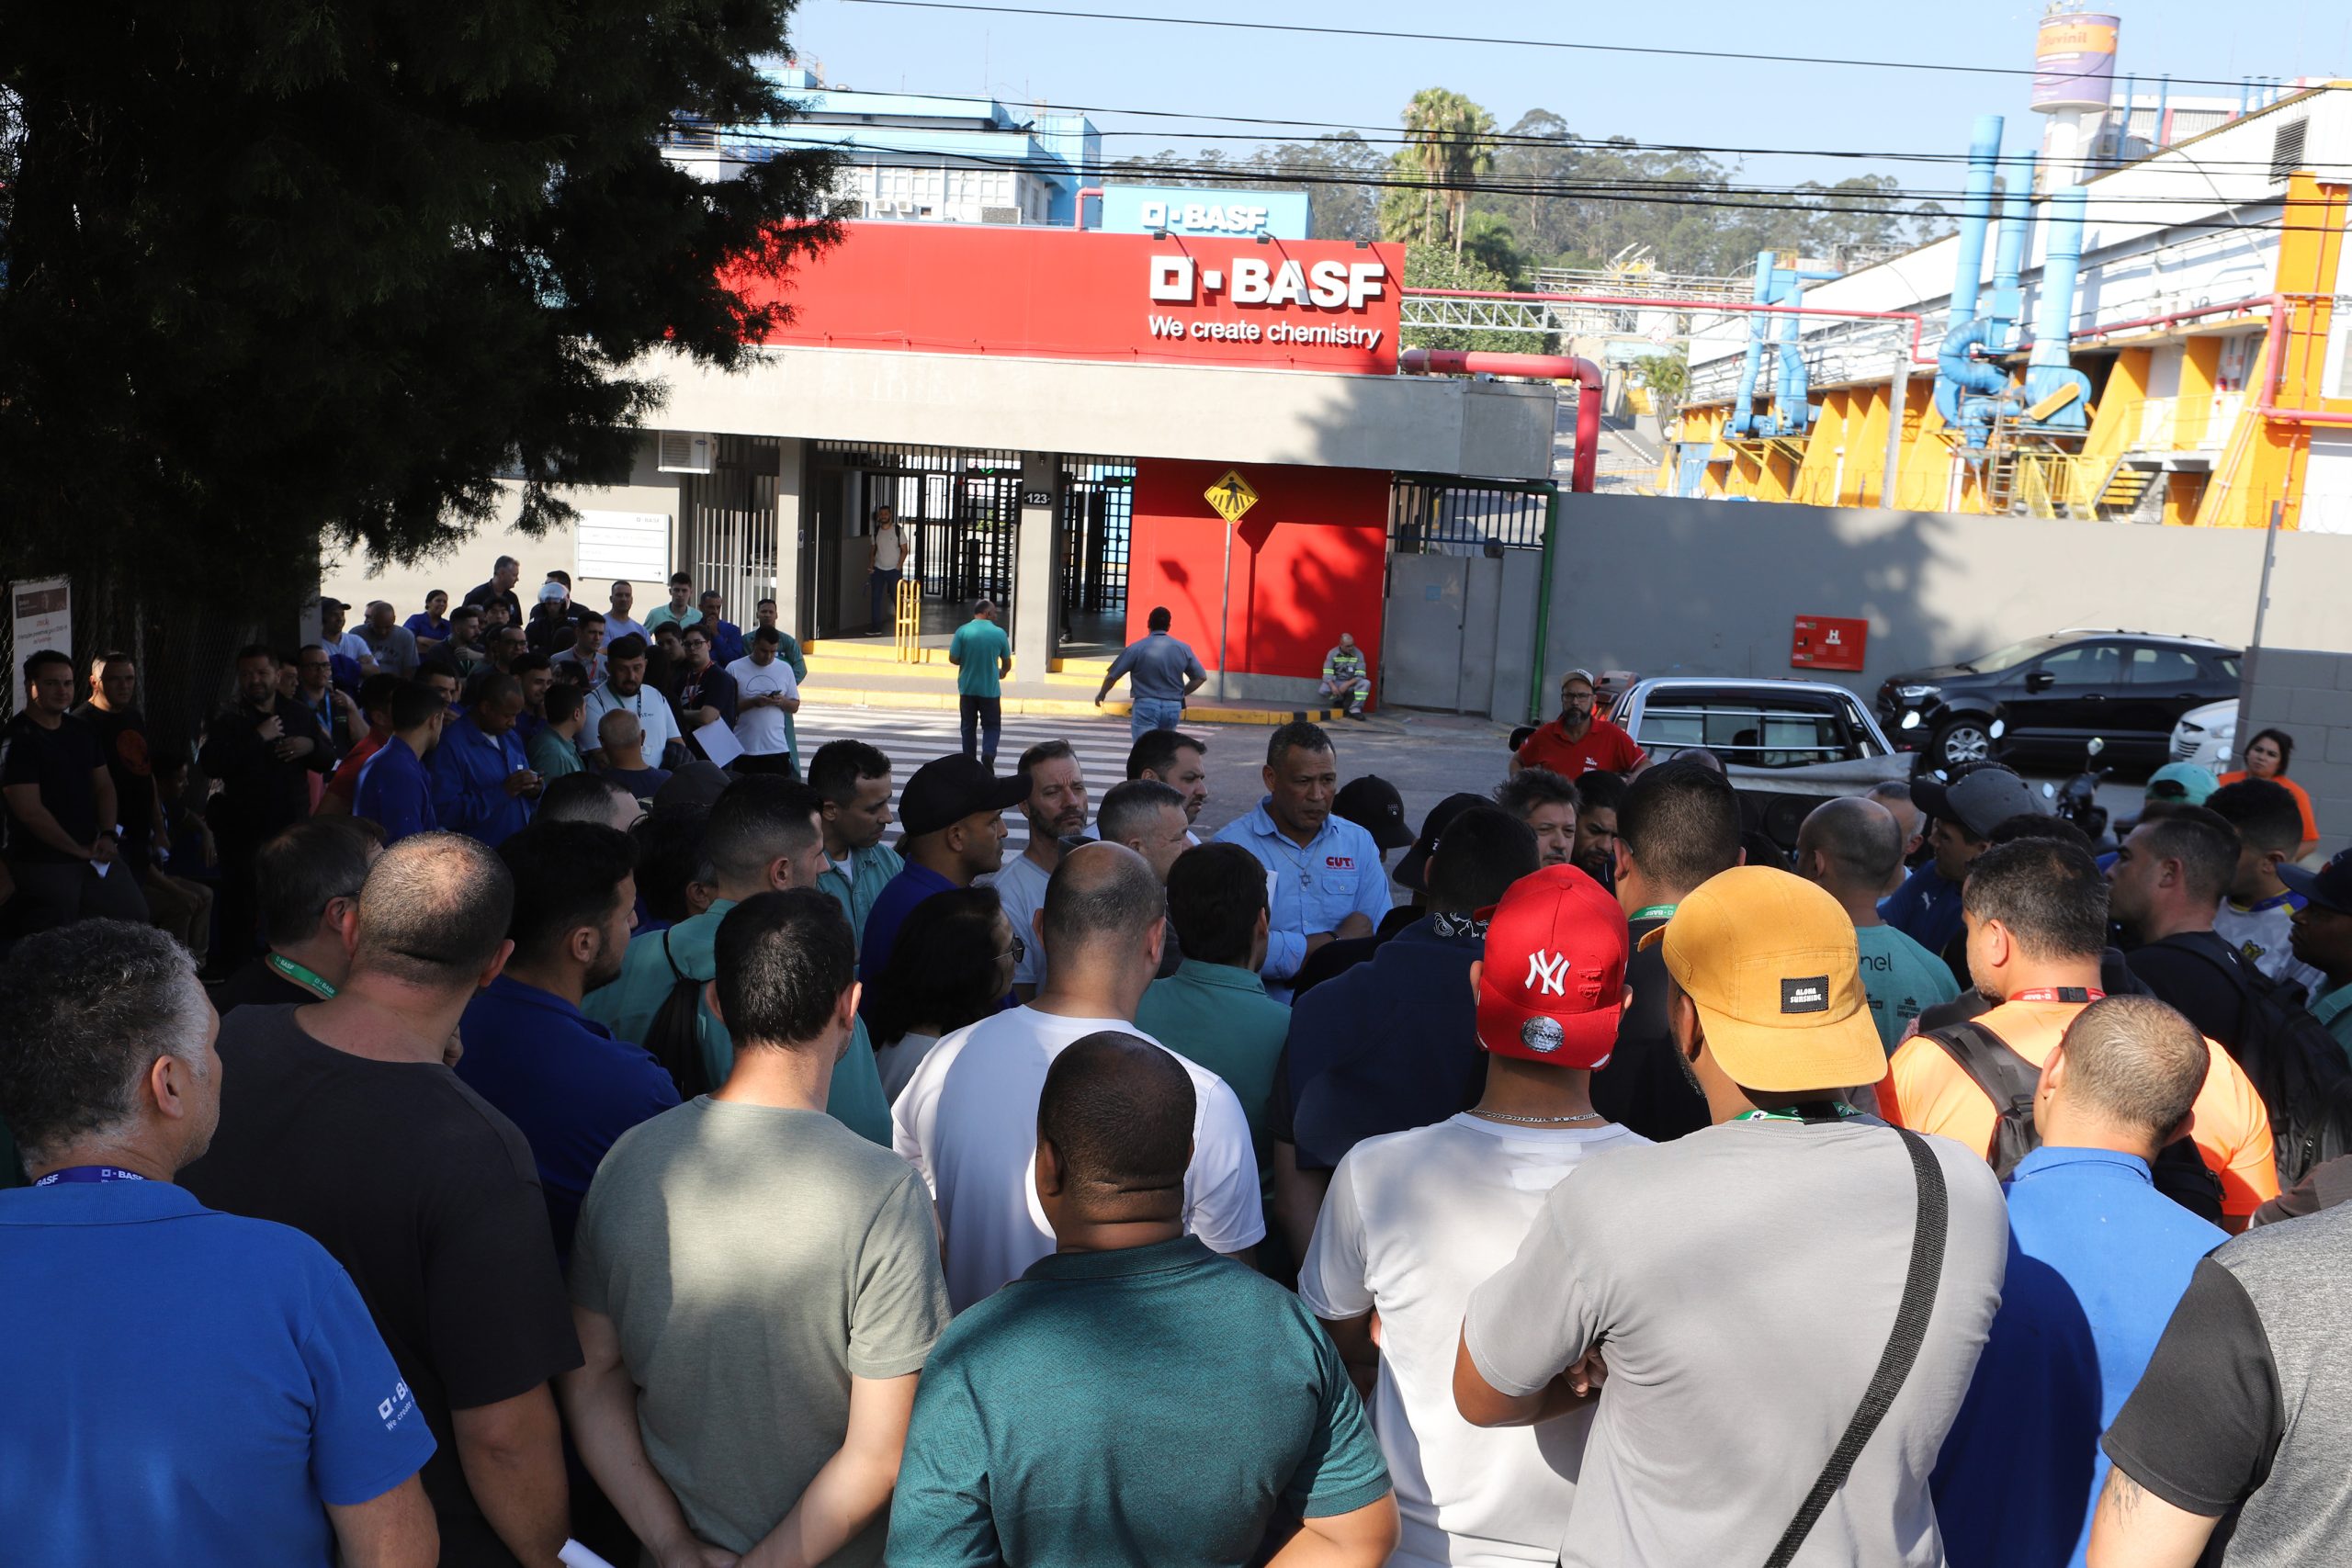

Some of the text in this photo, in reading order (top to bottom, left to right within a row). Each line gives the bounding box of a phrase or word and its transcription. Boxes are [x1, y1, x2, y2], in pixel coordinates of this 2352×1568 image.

[1184, 203, 1267, 231] BASF
[1231, 257, 1385, 308] BASF
[1148, 315, 1382, 350] We create chemistry
[1027, 492, 1047, 504] 123
[1828, 629, 1839, 640] H
[1325, 856, 1351, 867] CUT
[1524, 948, 1571, 997] NY
[1790, 993, 1822, 1003] SUNSHINE
[385, 1419, 398, 1431] We
